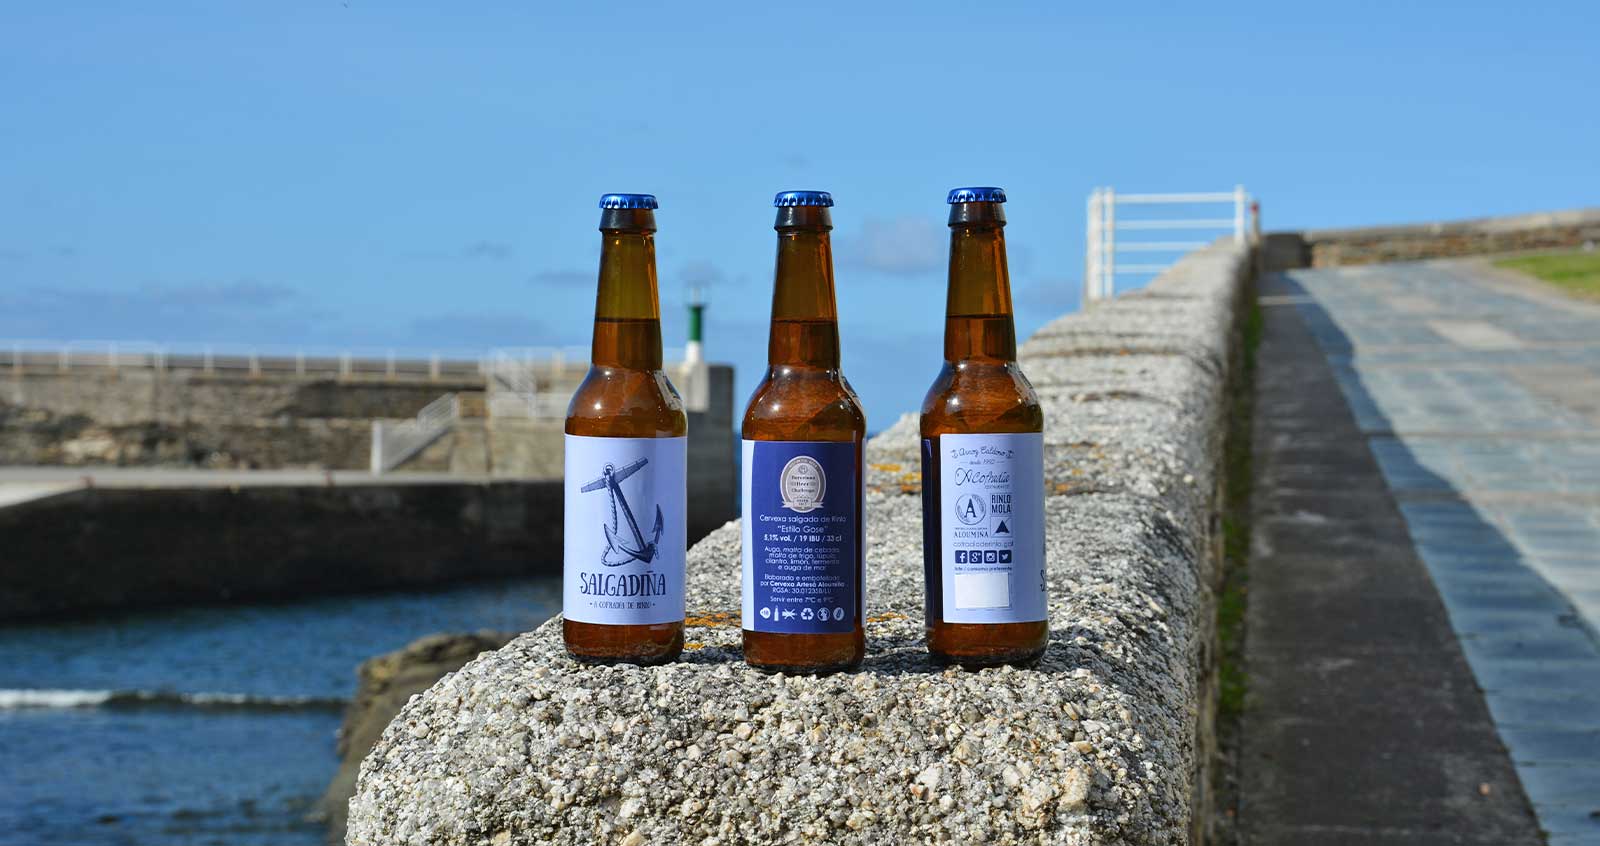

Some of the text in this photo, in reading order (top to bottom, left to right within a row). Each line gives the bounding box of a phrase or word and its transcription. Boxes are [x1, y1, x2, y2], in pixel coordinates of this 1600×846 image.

[991, 494, 1012, 504] RINLO
[964, 498, 977, 518] A
[991, 504, 1012, 514] MOLA
[760, 514, 787, 522] Cervexa
[788, 516, 819, 524] salgada
[579, 570, 667, 597] SALGADIÑA
